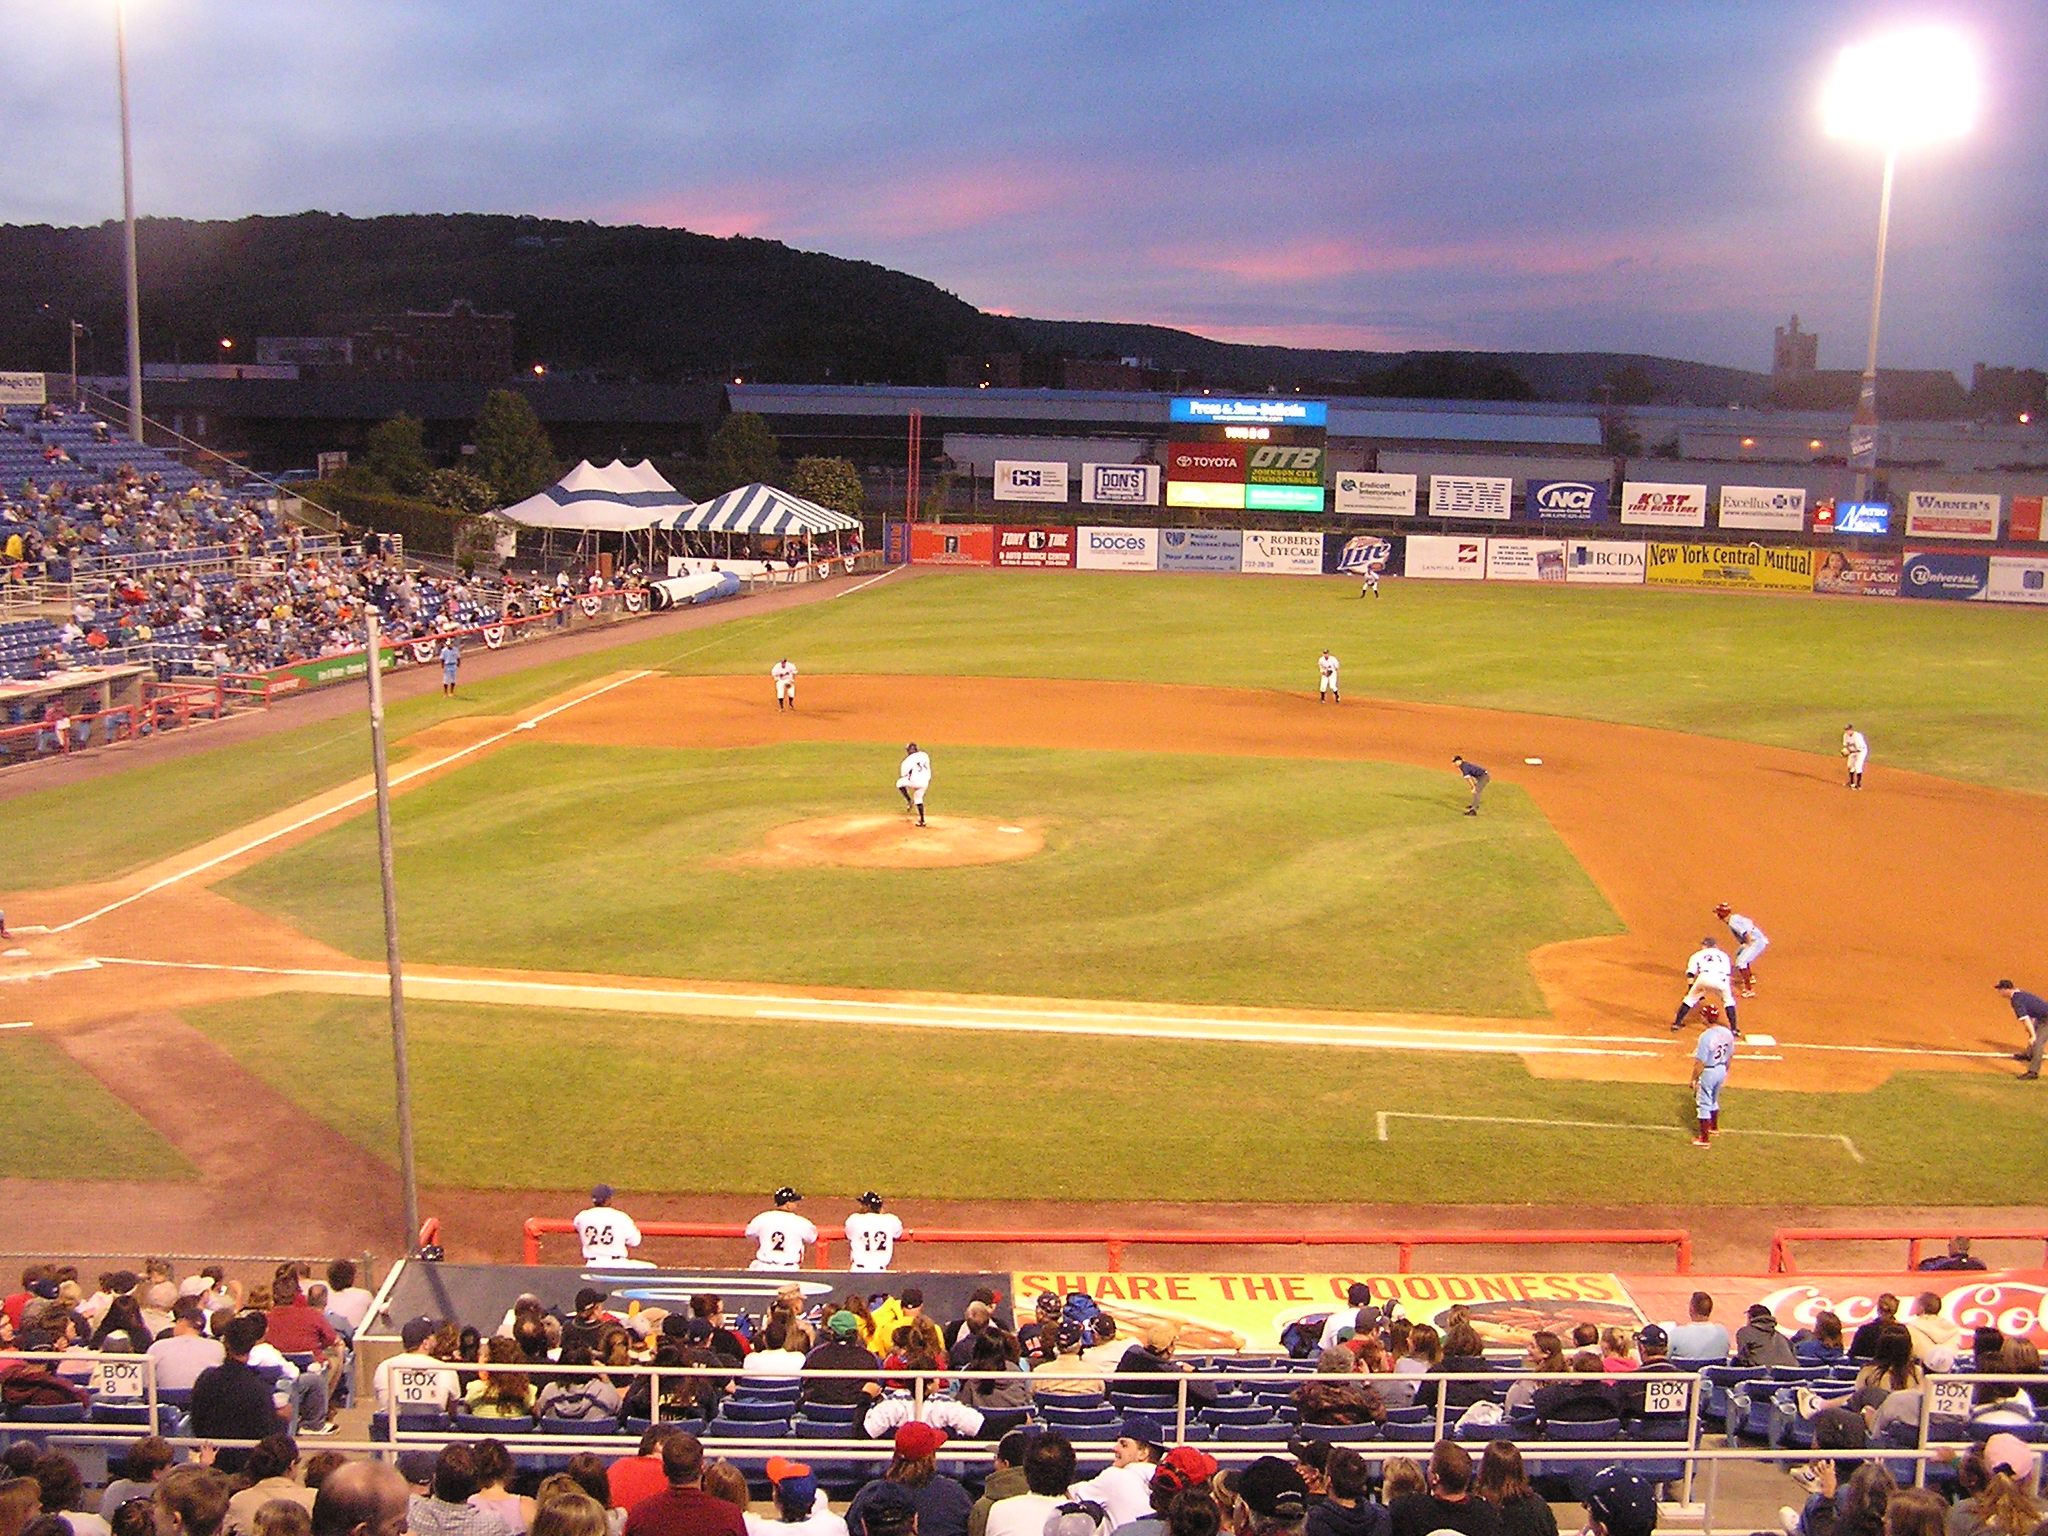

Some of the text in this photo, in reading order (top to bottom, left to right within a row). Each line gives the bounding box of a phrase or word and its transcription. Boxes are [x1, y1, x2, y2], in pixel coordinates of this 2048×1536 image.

[1194, 456, 1237, 467] TOYOTA
[1250, 446, 1321, 468] OTB
[1012, 469, 1041, 487] CSI
[1102, 473, 1140, 488] DON'S
[1252, 469, 1294, 477] JOHNSON
[1359, 481, 1390, 489] Endicott
[1359, 489, 1406, 497] Interconnect
[1436, 480, 1506, 513] IBM
[1549, 491, 1595, 508] NCI
[1722, 495, 1770, 509] Excellus
[1001, 533, 1026, 546] TONY
[1048, 533, 1069, 547] TIRE
[1090, 532, 1145, 550] boces
[1270, 535, 1320, 546] ROBERTS
[1270, 547, 1320, 557] EYECARE
[1342, 544, 1389, 568] Lite
[1596, 552, 1644, 567] BCIDA
[1650, 544, 1812, 576] New York Central Mutual
[1841, 571, 1898, 583] GET LASIK!
[770, 1231, 785, 1251] 2
[863, 1231, 887, 1252] 12
[1021, 1275, 1613, 1301] SHARE THE GOODNESS
[104, 1364, 138, 1379] BOX
[402, 1372, 436, 1387] BOX
[105, 1381, 117, 1394] 8
[405, 1387, 422, 1401] 10
[1650, 1383, 1684, 1396] BOX
[1935, 1384, 1968, 1399] BOX
[1653, 1398, 1669, 1410] 10
[1937, 1400, 1952, 1412] 12
